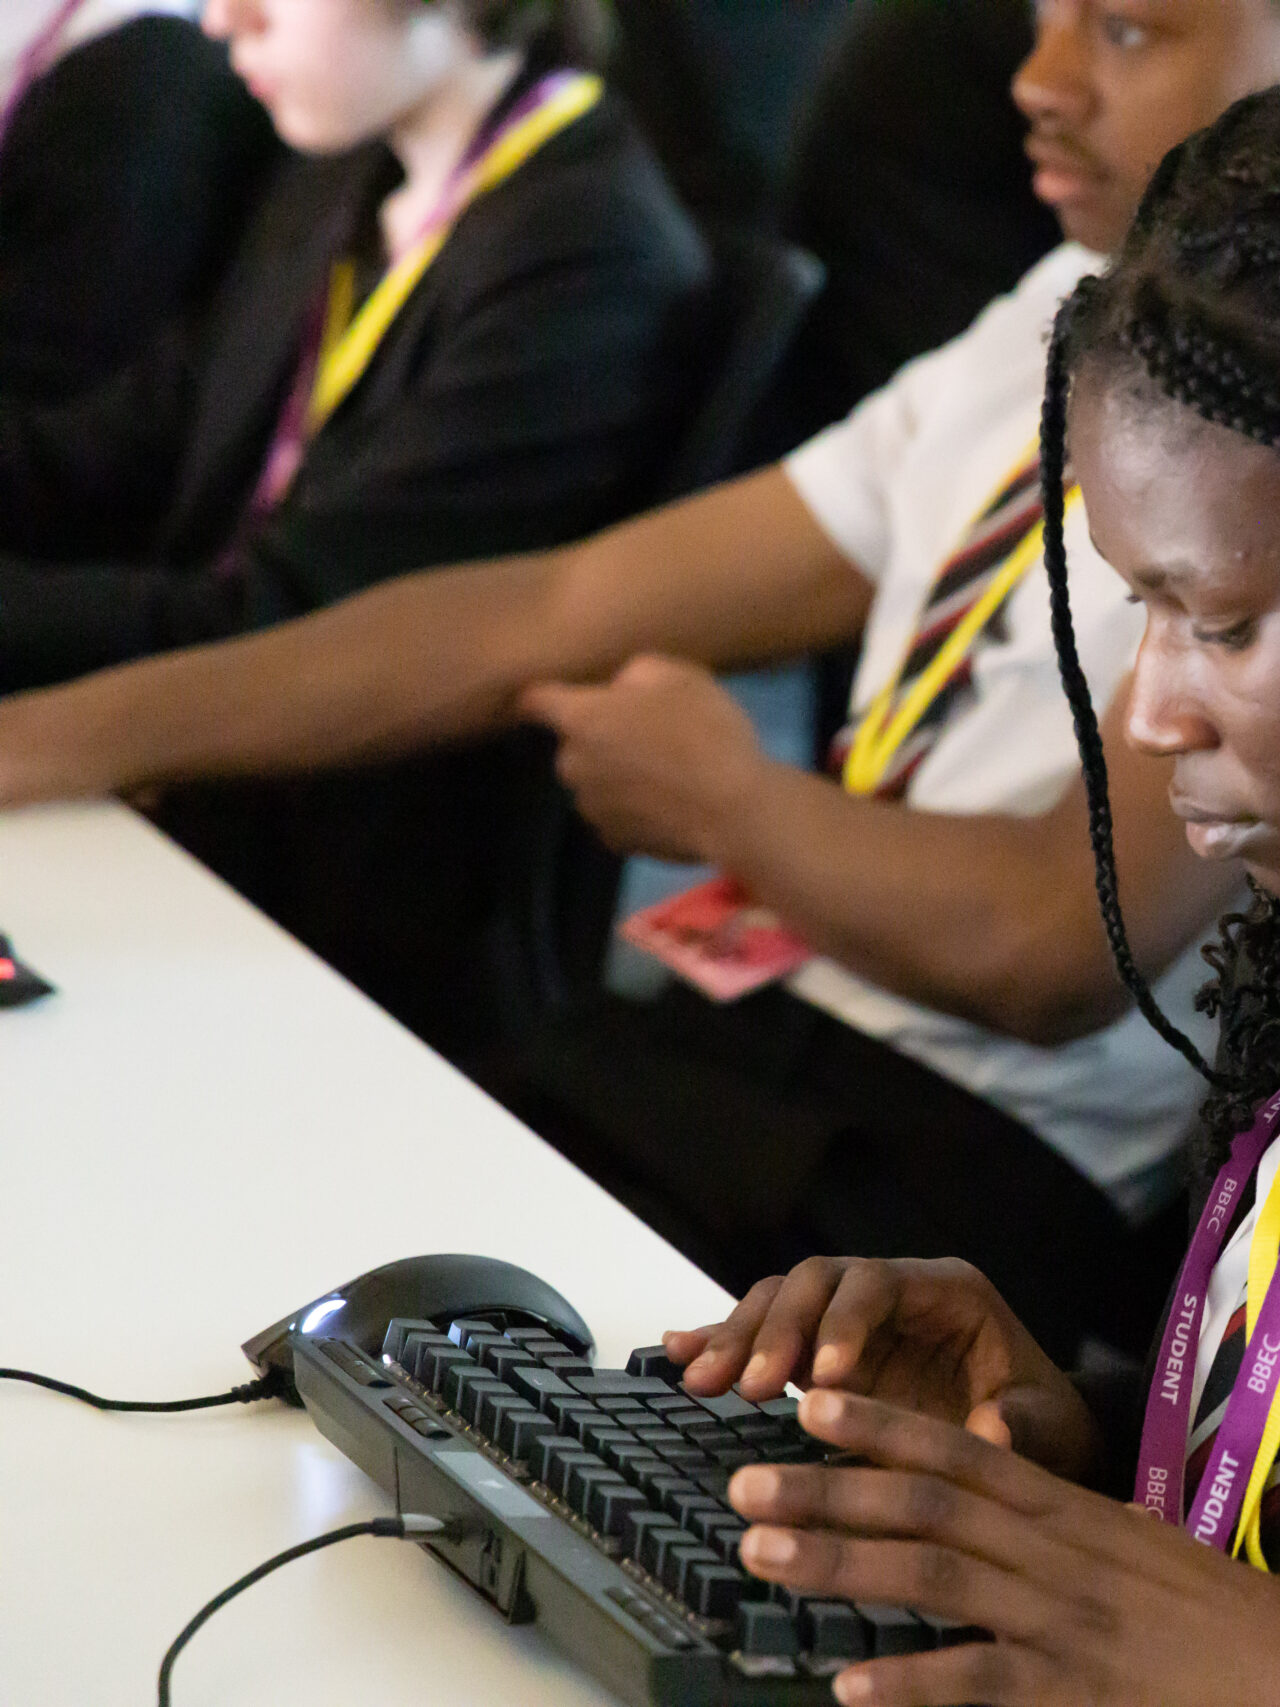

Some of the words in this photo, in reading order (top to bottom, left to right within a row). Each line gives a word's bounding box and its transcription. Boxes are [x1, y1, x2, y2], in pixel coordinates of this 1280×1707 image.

[1207, 1178, 1238, 1233] BBEC
[1160, 1293, 1198, 1405] STUDENT
[1195, 1450, 1239, 1546] TUDENT
